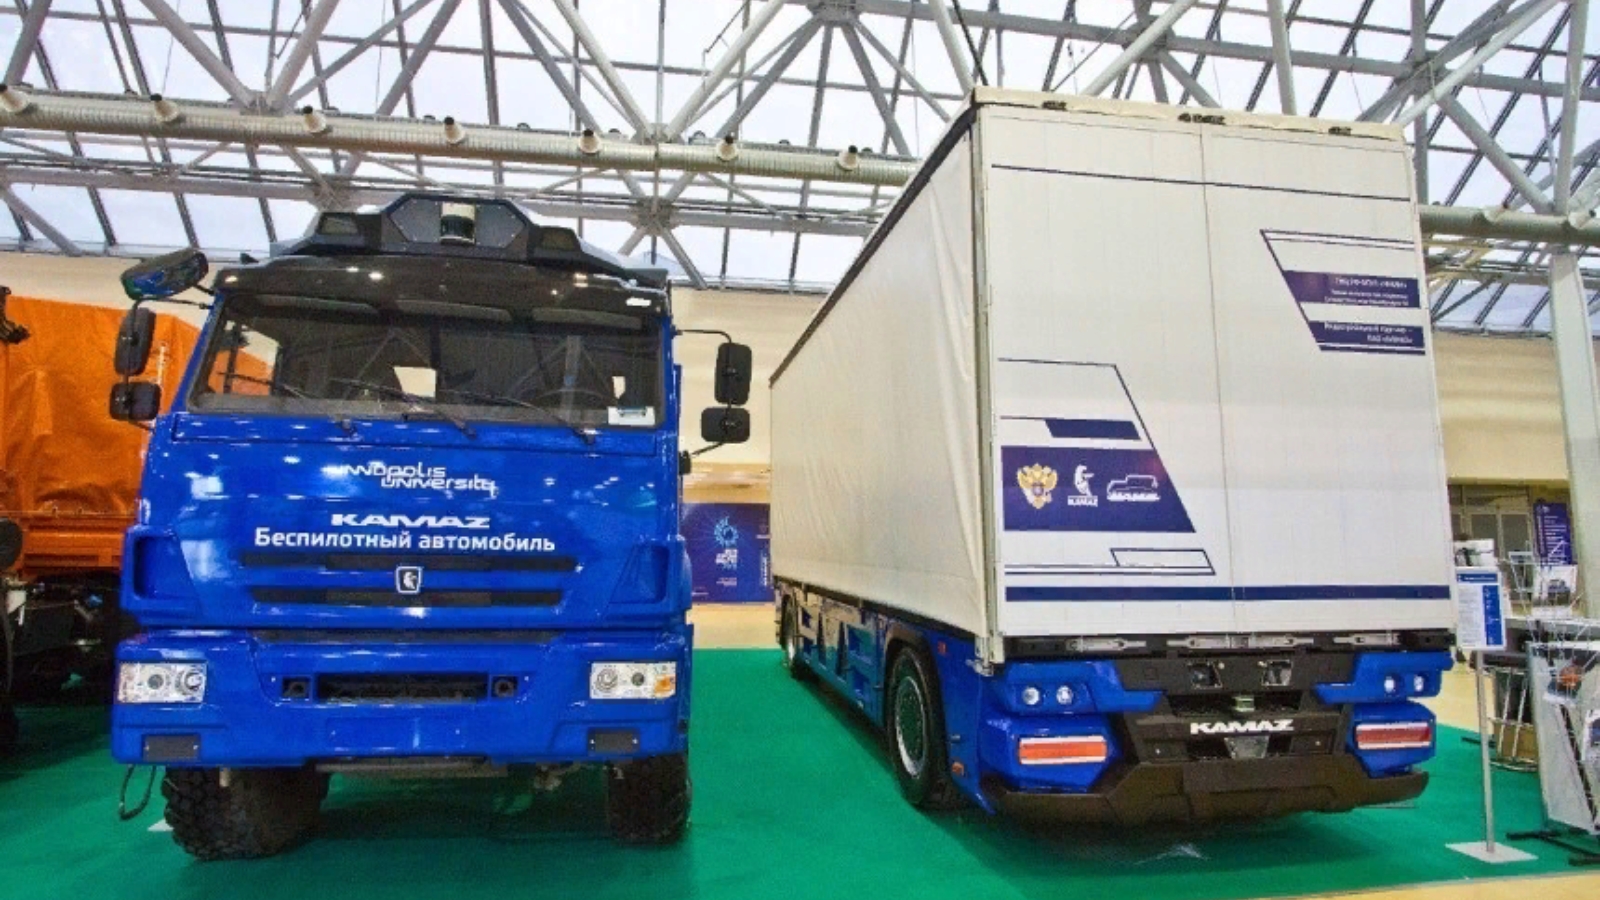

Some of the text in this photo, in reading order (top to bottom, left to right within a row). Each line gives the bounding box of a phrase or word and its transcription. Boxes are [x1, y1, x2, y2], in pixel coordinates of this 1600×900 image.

[331, 513, 491, 529] KAMAZ
[254, 527, 556, 551] Беспилотный автомобиль
[1190, 719, 1295, 735] KAMAZ
